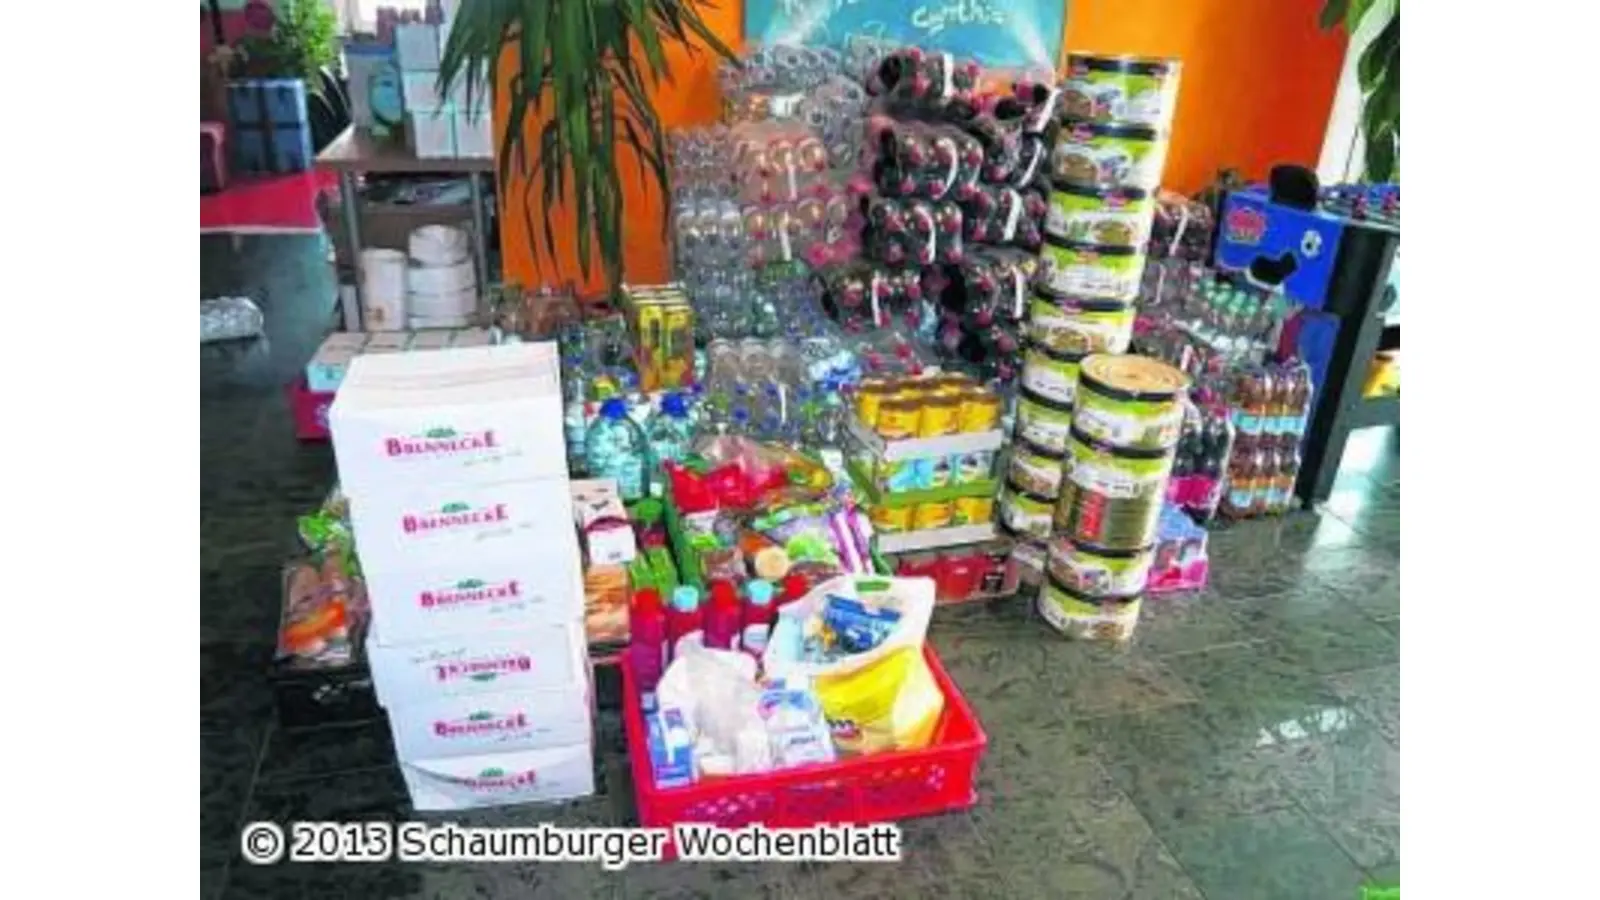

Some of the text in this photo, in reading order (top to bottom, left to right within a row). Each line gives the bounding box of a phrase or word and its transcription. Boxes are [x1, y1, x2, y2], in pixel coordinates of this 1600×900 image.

[385, 430, 497, 457] BRENNECKE
[402, 503, 509, 533] BRENNECKE
[420, 580, 520, 608] BRENNECKE
